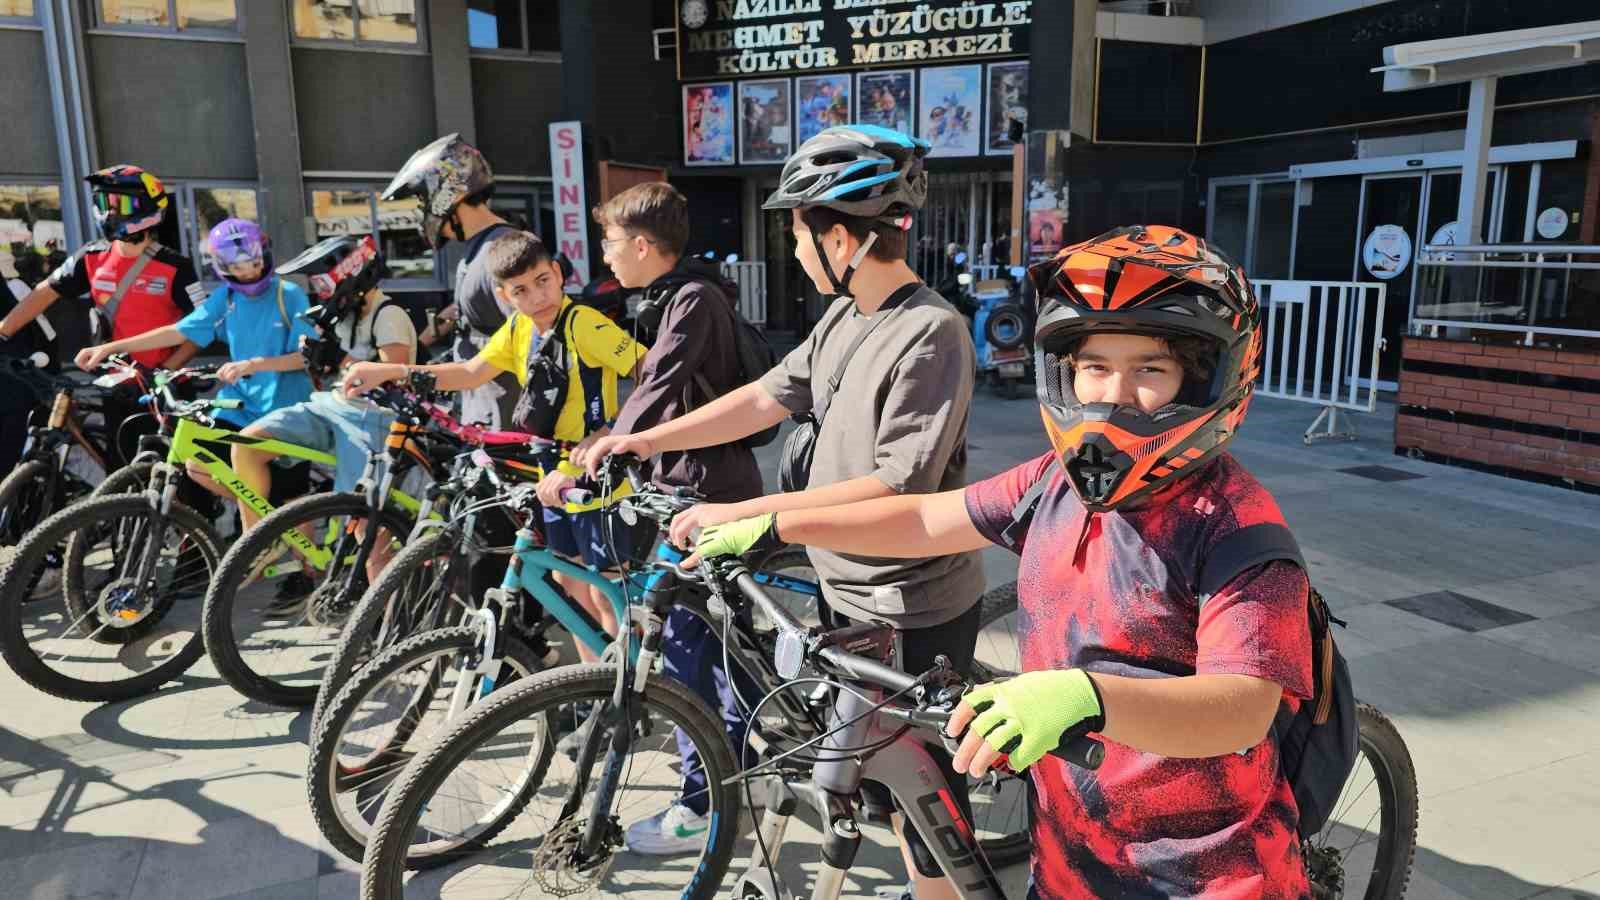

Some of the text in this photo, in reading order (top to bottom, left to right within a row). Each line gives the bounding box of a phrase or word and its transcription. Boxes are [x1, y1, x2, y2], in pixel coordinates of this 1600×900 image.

[688, 20, 824, 53] MEHMET
[717, 27, 1013, 73] KÜLTÜR MERKEZİ
[556, 128, 585, 288] SİNEMA
